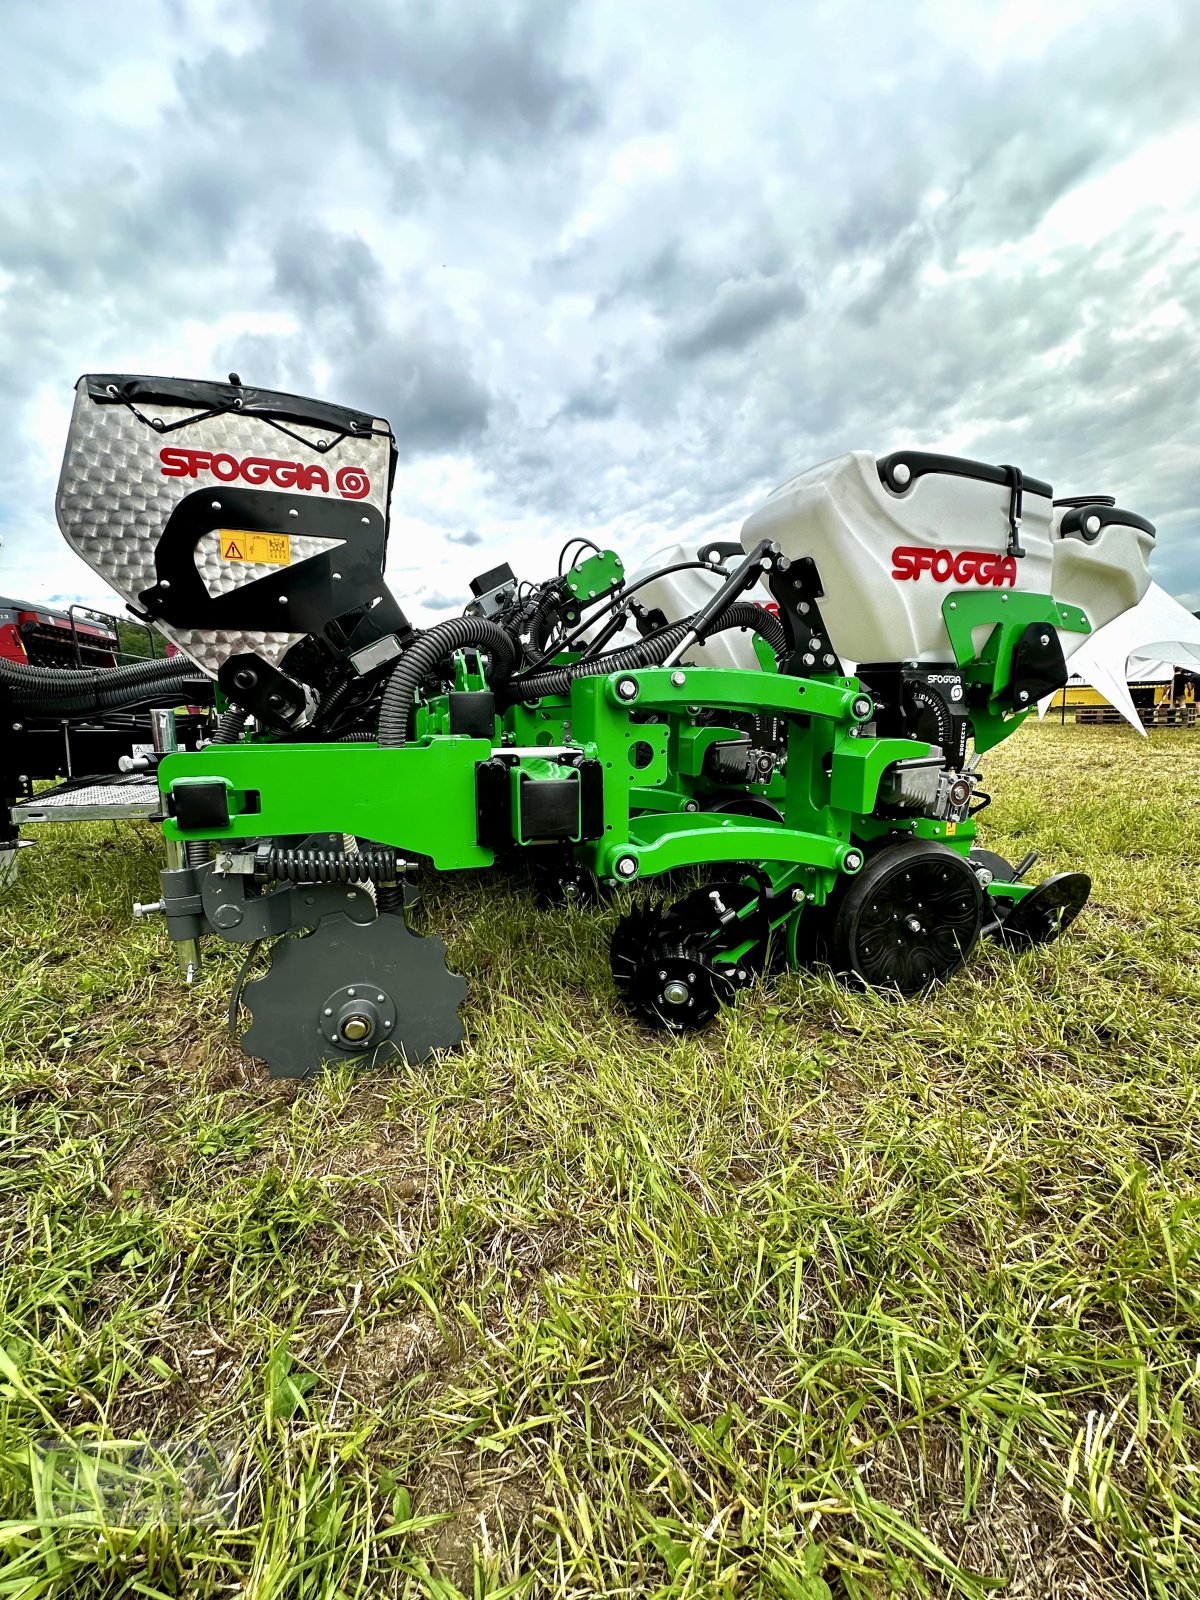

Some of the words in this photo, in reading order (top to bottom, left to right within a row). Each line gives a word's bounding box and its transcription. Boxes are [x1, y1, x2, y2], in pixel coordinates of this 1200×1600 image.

[160, 447, 329, 493] SFOGGIA
[892, 546, 1017, 587] SFOGGIA
[927, 674, 961, 684] SFOGGIA
